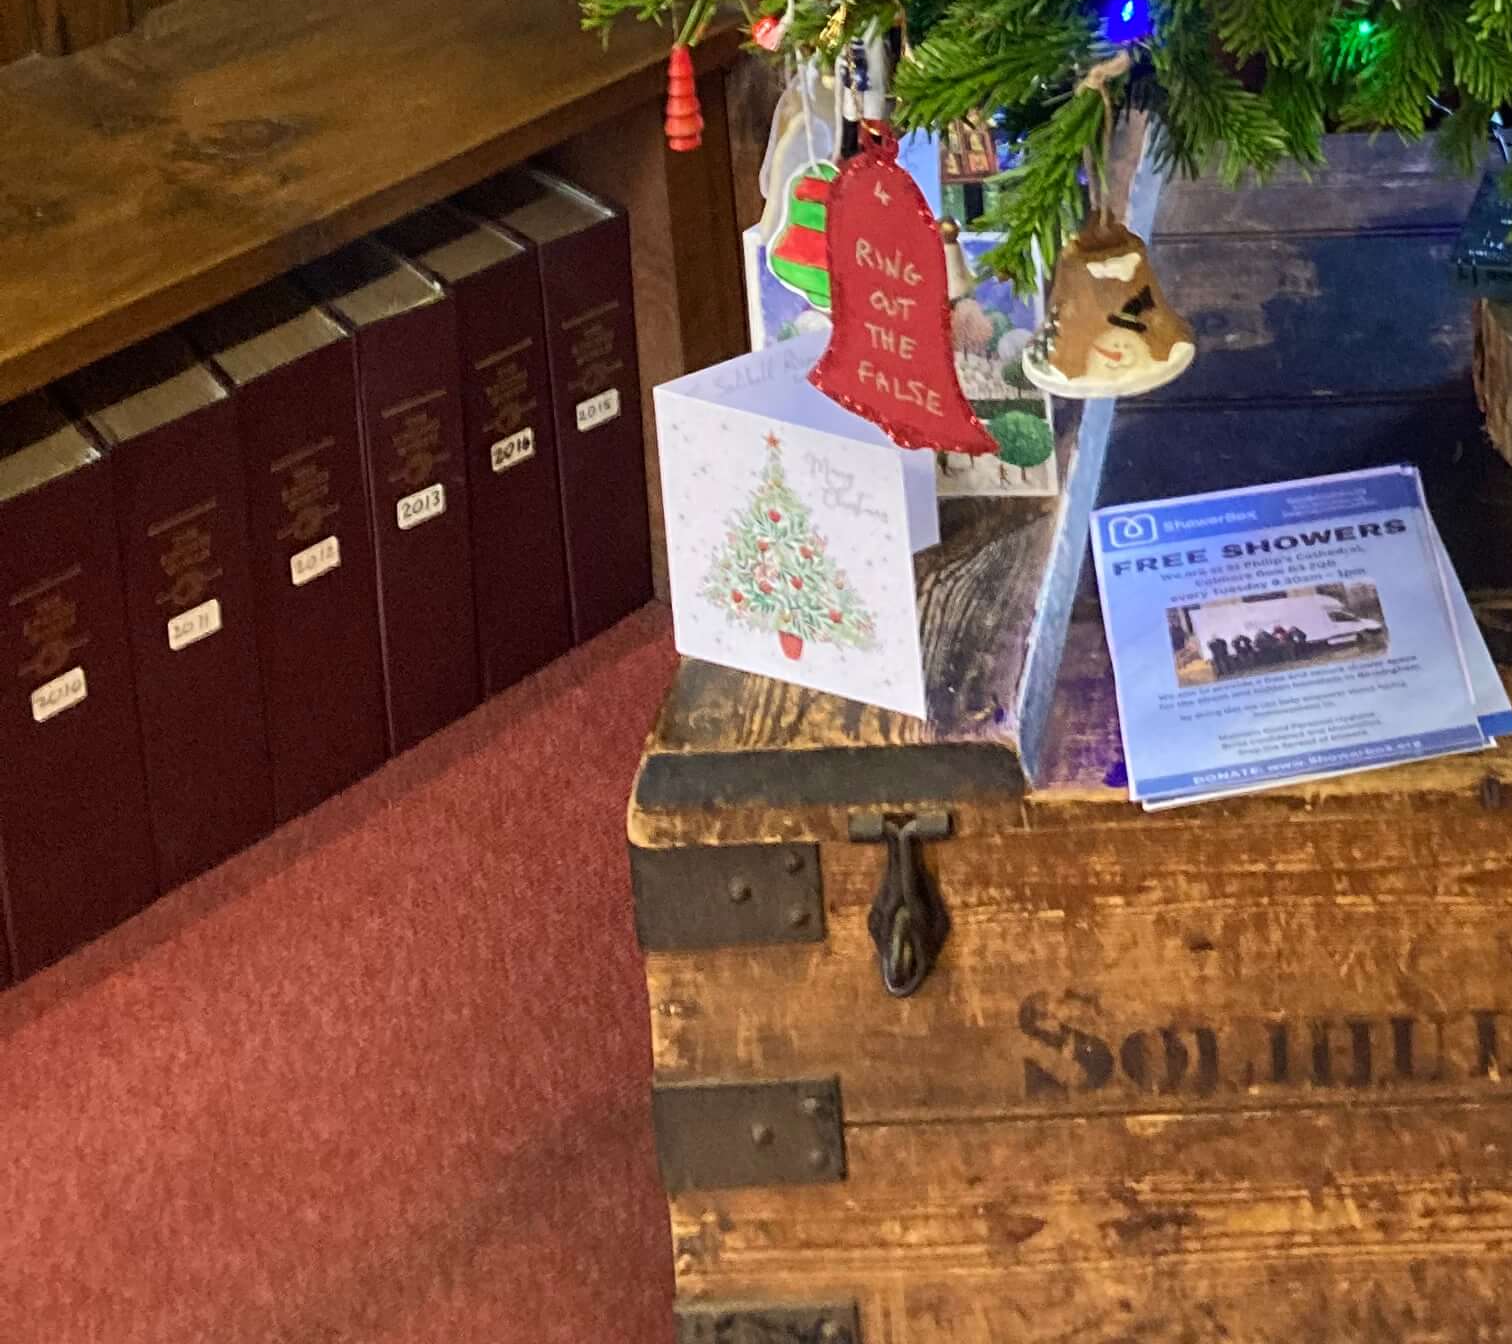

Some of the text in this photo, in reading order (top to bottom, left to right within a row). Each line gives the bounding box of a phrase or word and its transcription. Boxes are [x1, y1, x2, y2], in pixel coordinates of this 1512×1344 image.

[855, 237, 923, 287] RING
[869, 291, 917, 320] OUT
[864, 322, 919, 360] THE
[857, 360, 945, 417] FALSE
[402, 490, 441, 519] 2013
[1112, 518, 1408, 576] FREE SHOWERS
